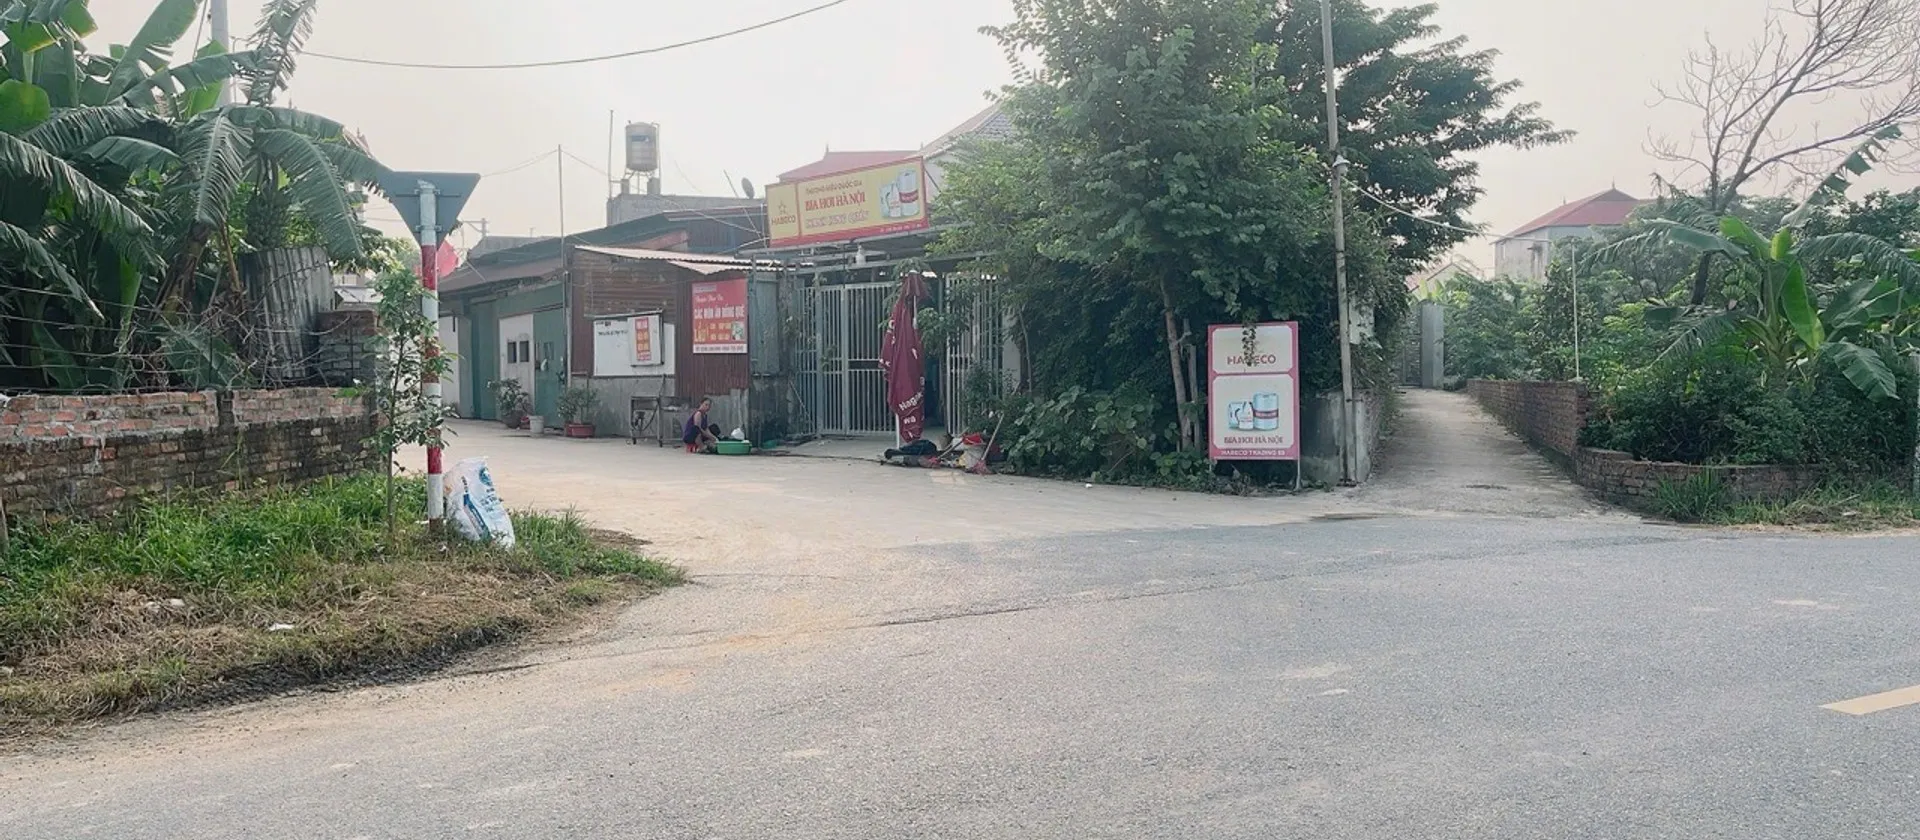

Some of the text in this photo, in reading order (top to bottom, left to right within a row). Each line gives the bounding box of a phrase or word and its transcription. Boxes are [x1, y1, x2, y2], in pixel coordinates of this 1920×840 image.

[805, 200, 819, 212] BIA
[836, 191, 849, 206] HÀ
[849, 188, 866, 206] NỘI
[1224, 436, 1237, 444] BIA
[1254, 435, 1268, 444] HÀ
[1268, 434, 1283, 445] NỘI
